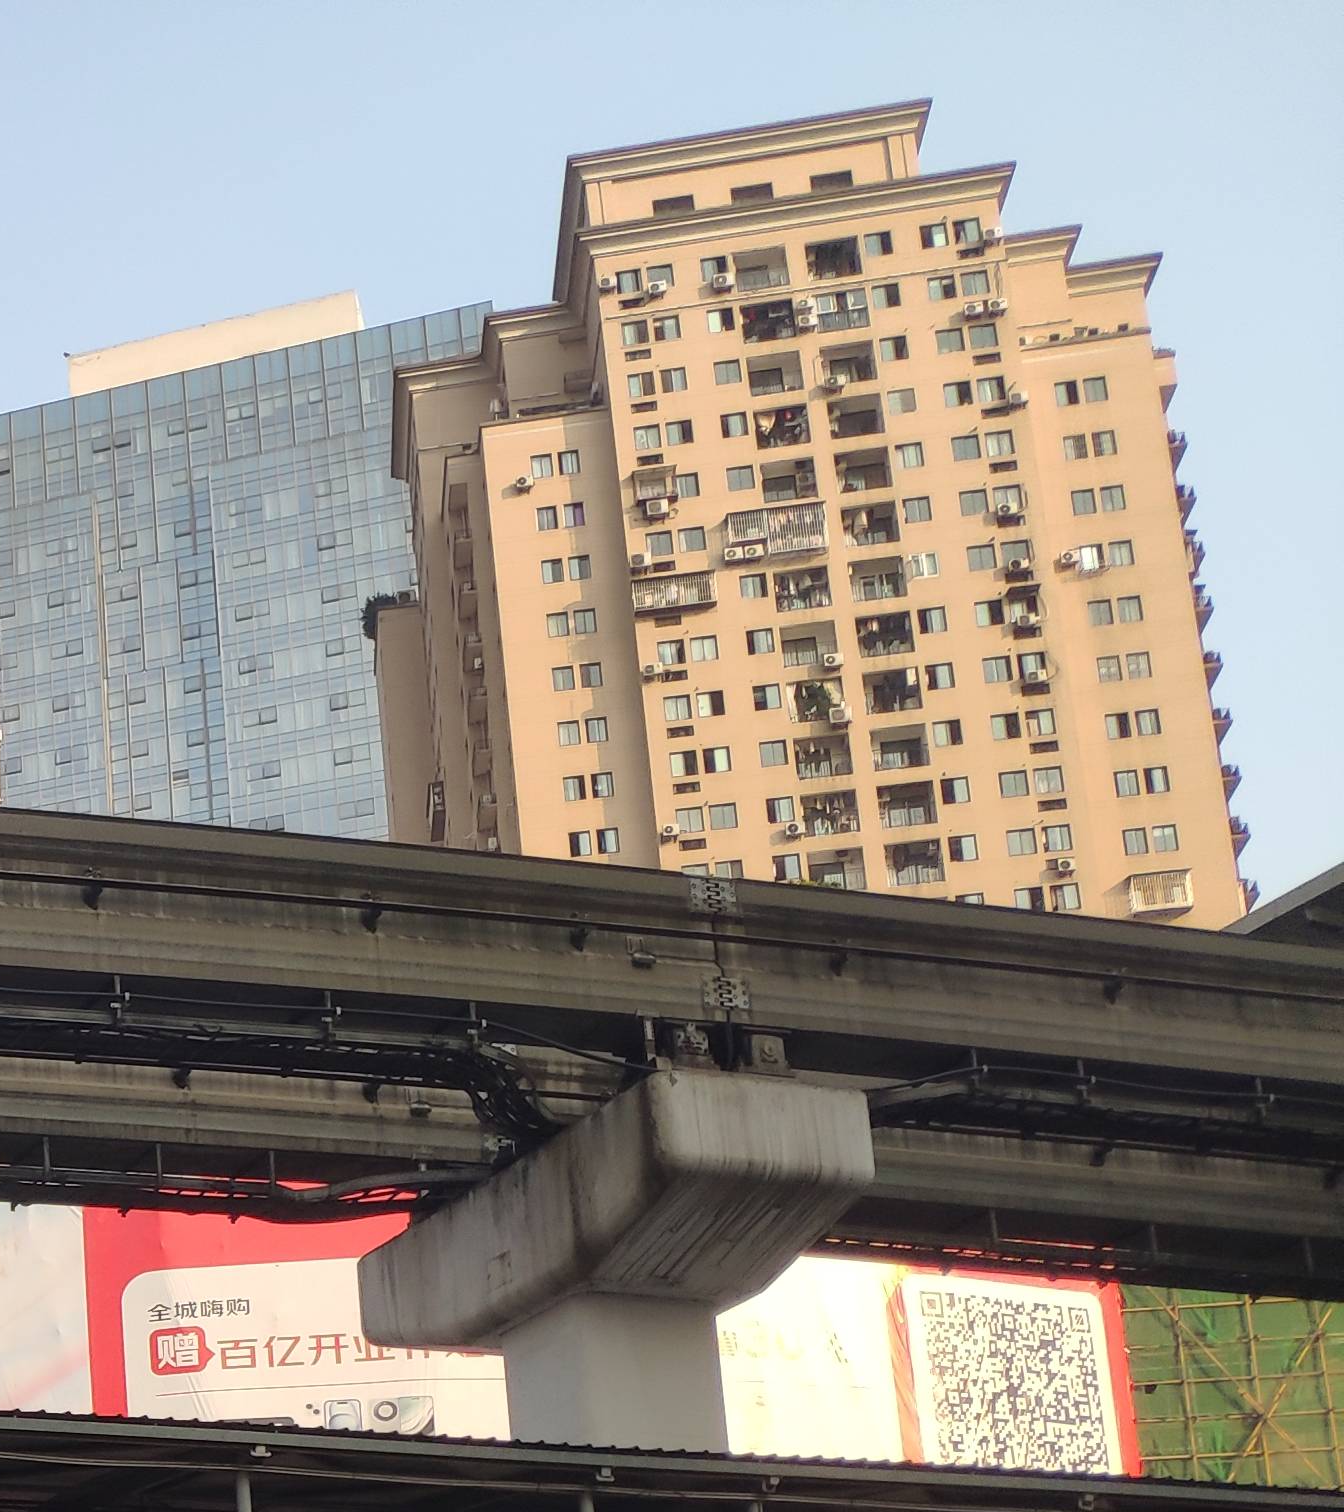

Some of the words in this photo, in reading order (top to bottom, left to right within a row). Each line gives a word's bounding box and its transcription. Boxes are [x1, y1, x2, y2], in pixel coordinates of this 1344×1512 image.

[147, 1298, 251, 1322] 全城嗨购
[156, 1331, 202, 1369] 赠
